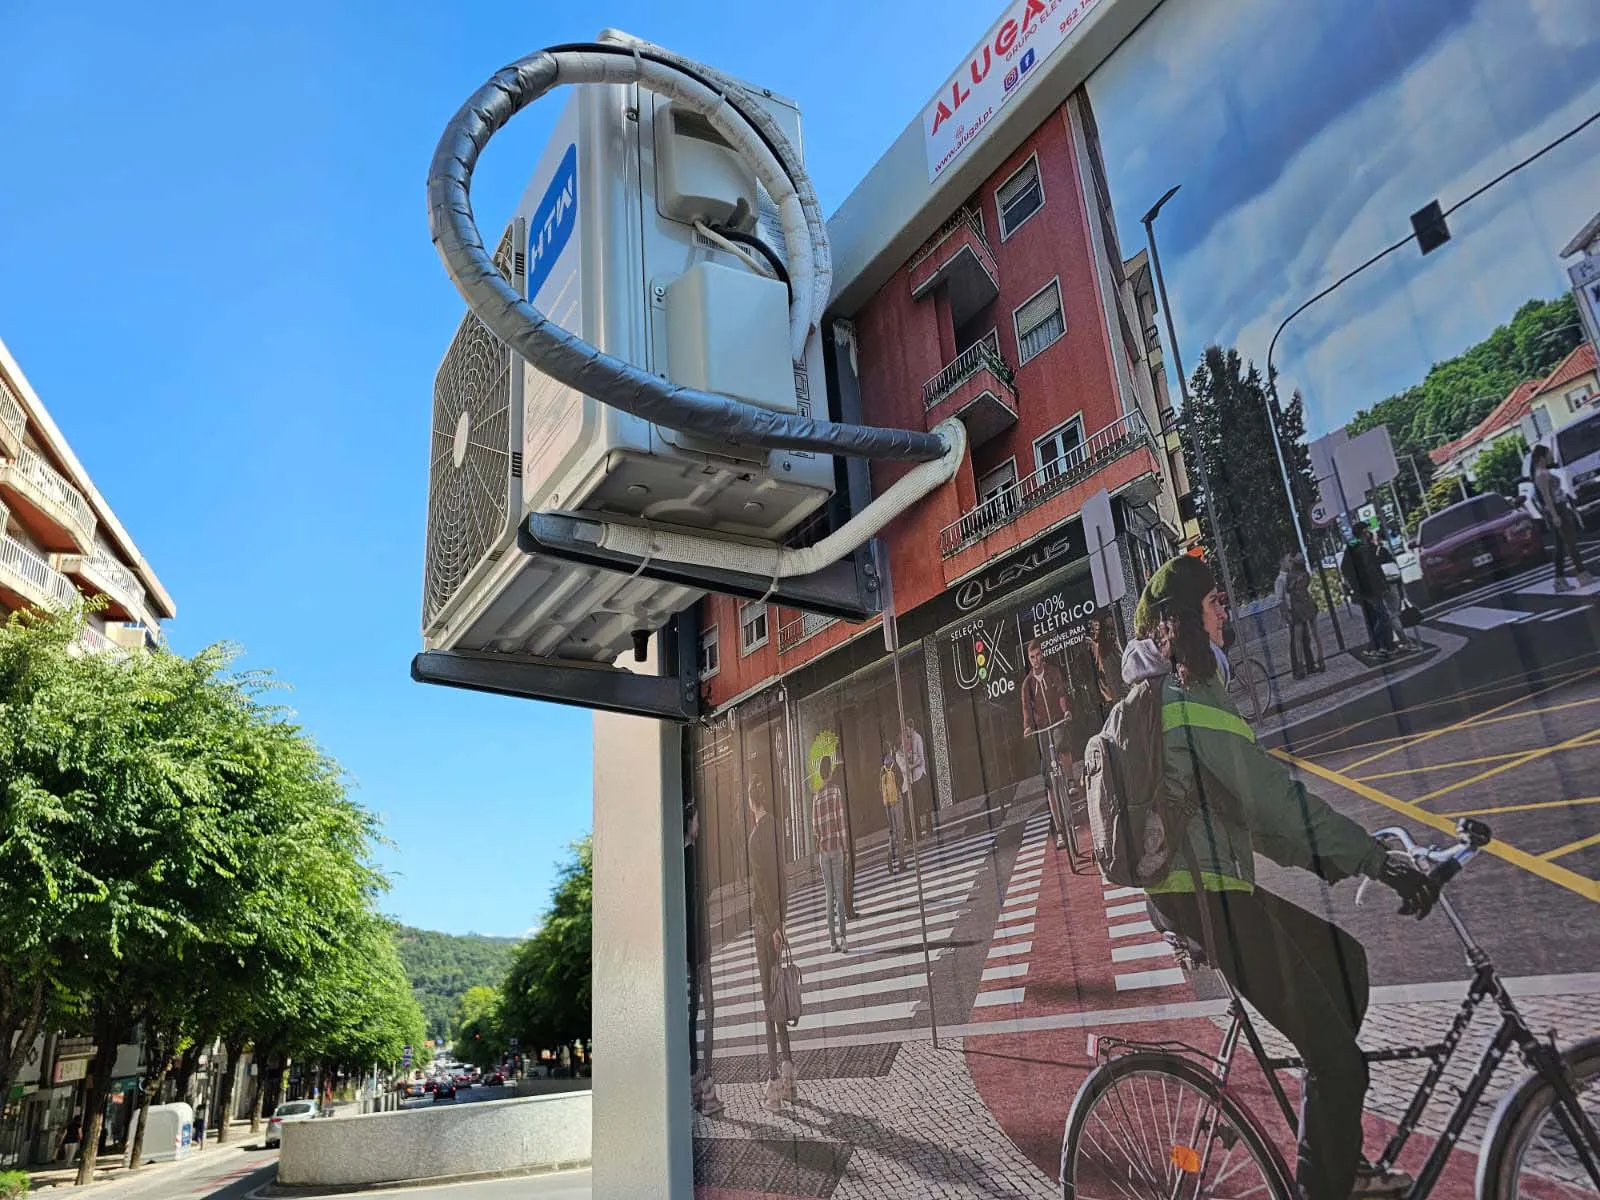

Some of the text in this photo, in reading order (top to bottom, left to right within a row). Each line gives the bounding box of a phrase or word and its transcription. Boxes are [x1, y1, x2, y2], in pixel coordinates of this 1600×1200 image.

[1005, 23, 1037, 62] GRUPO
[1039, 0, 1062, 24] ELE
[1059, 8, 1079, 33] 962
[932, 0, 1051, 136] ALUGA
[934, 106, 994, 173] www.alugal.pt
[531, 173, 573, 275] HTW
[984, 536, 1070, 592] LEXUS
[950, 619, 984, 642] SELEÇÃO
[1031, 592, 1065, 622] 100%
[1033, 600, 1095, 639] ELÉTRICO
[1069, 624, 1086, 637] PARA
